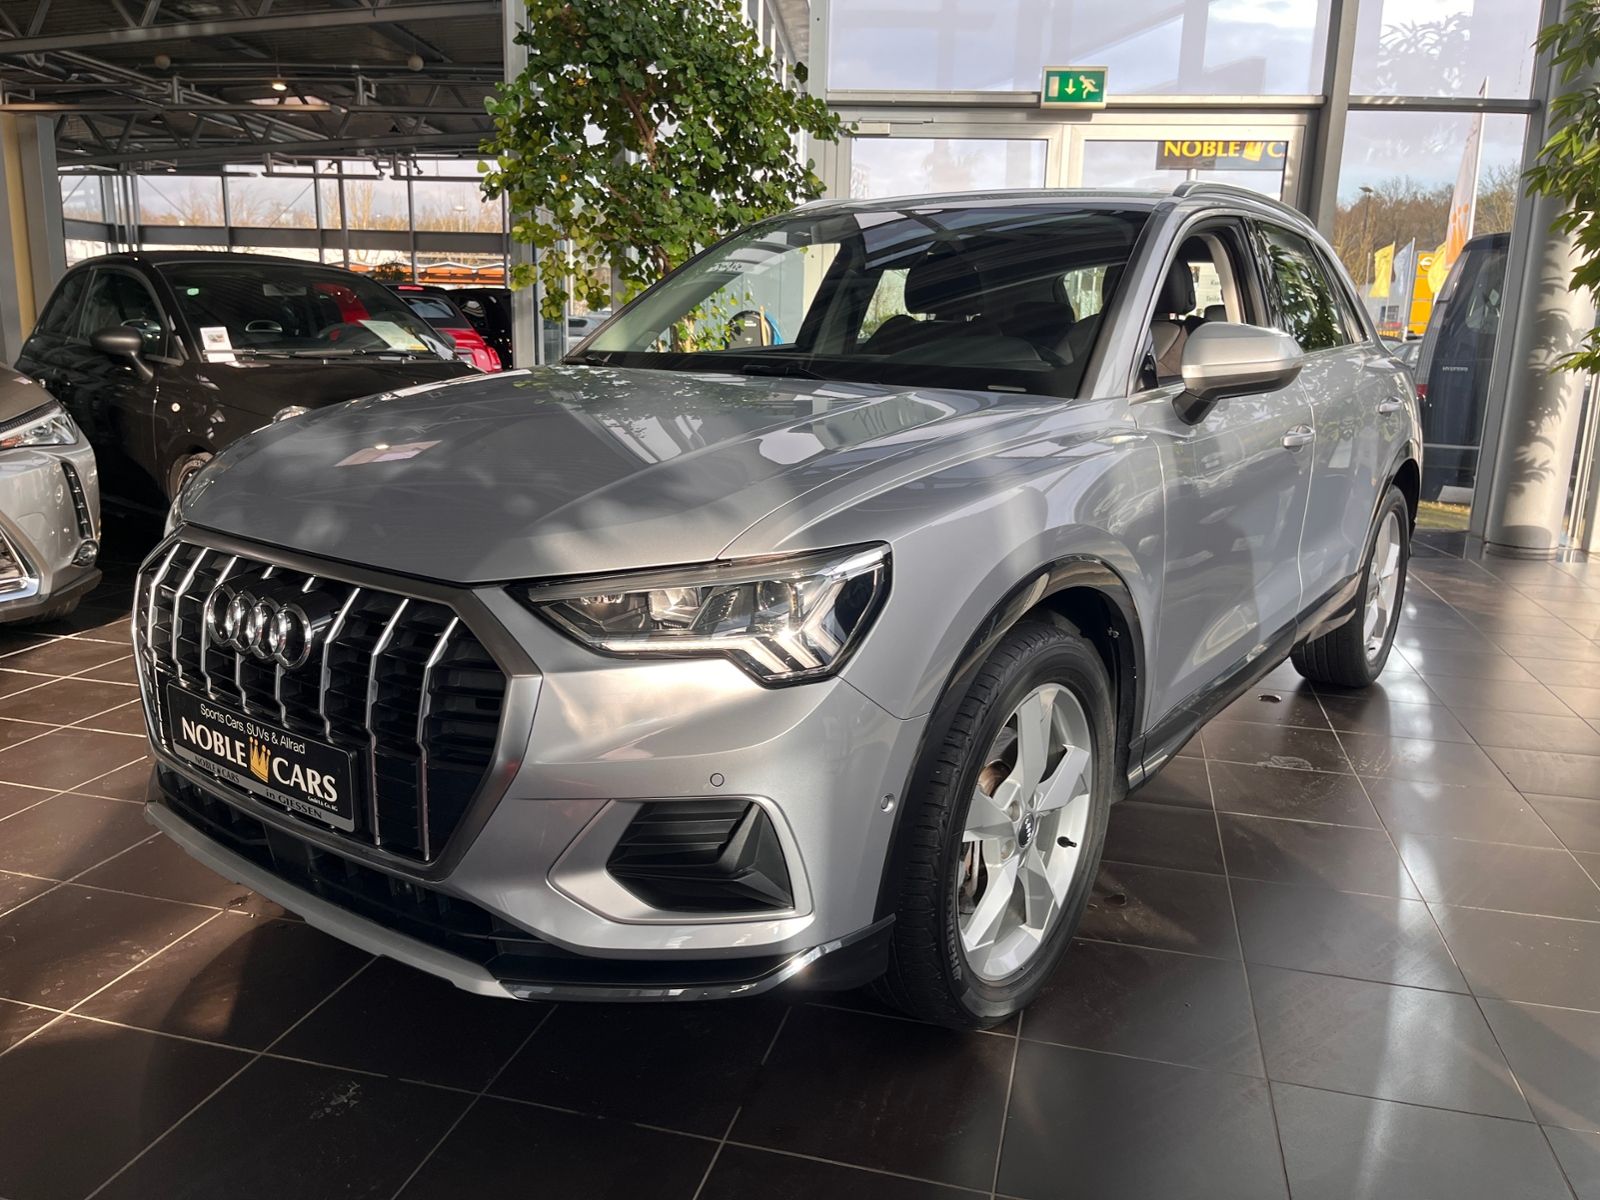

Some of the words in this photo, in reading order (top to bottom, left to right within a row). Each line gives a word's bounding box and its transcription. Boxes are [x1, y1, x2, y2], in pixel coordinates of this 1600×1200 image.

[1164, 141, 1240, 157] NOBLE
[1266, 141, 1286, 157] C
[200, 703, 225, 725] Sports
[225, 714, 246, 734] Cars,
[246, 722, 270, 742] SUVs
[271, 732, 279, 745] &
[280, 735, 305, 754] Allrad
[181, 716, 248, 768] NOBLE
[272, 757, 338, 802] CARS
[221, 768, 240, 783] CARS
[265, 788, 277, 800] in
[278, 794, 323, 819] GIESSEN
